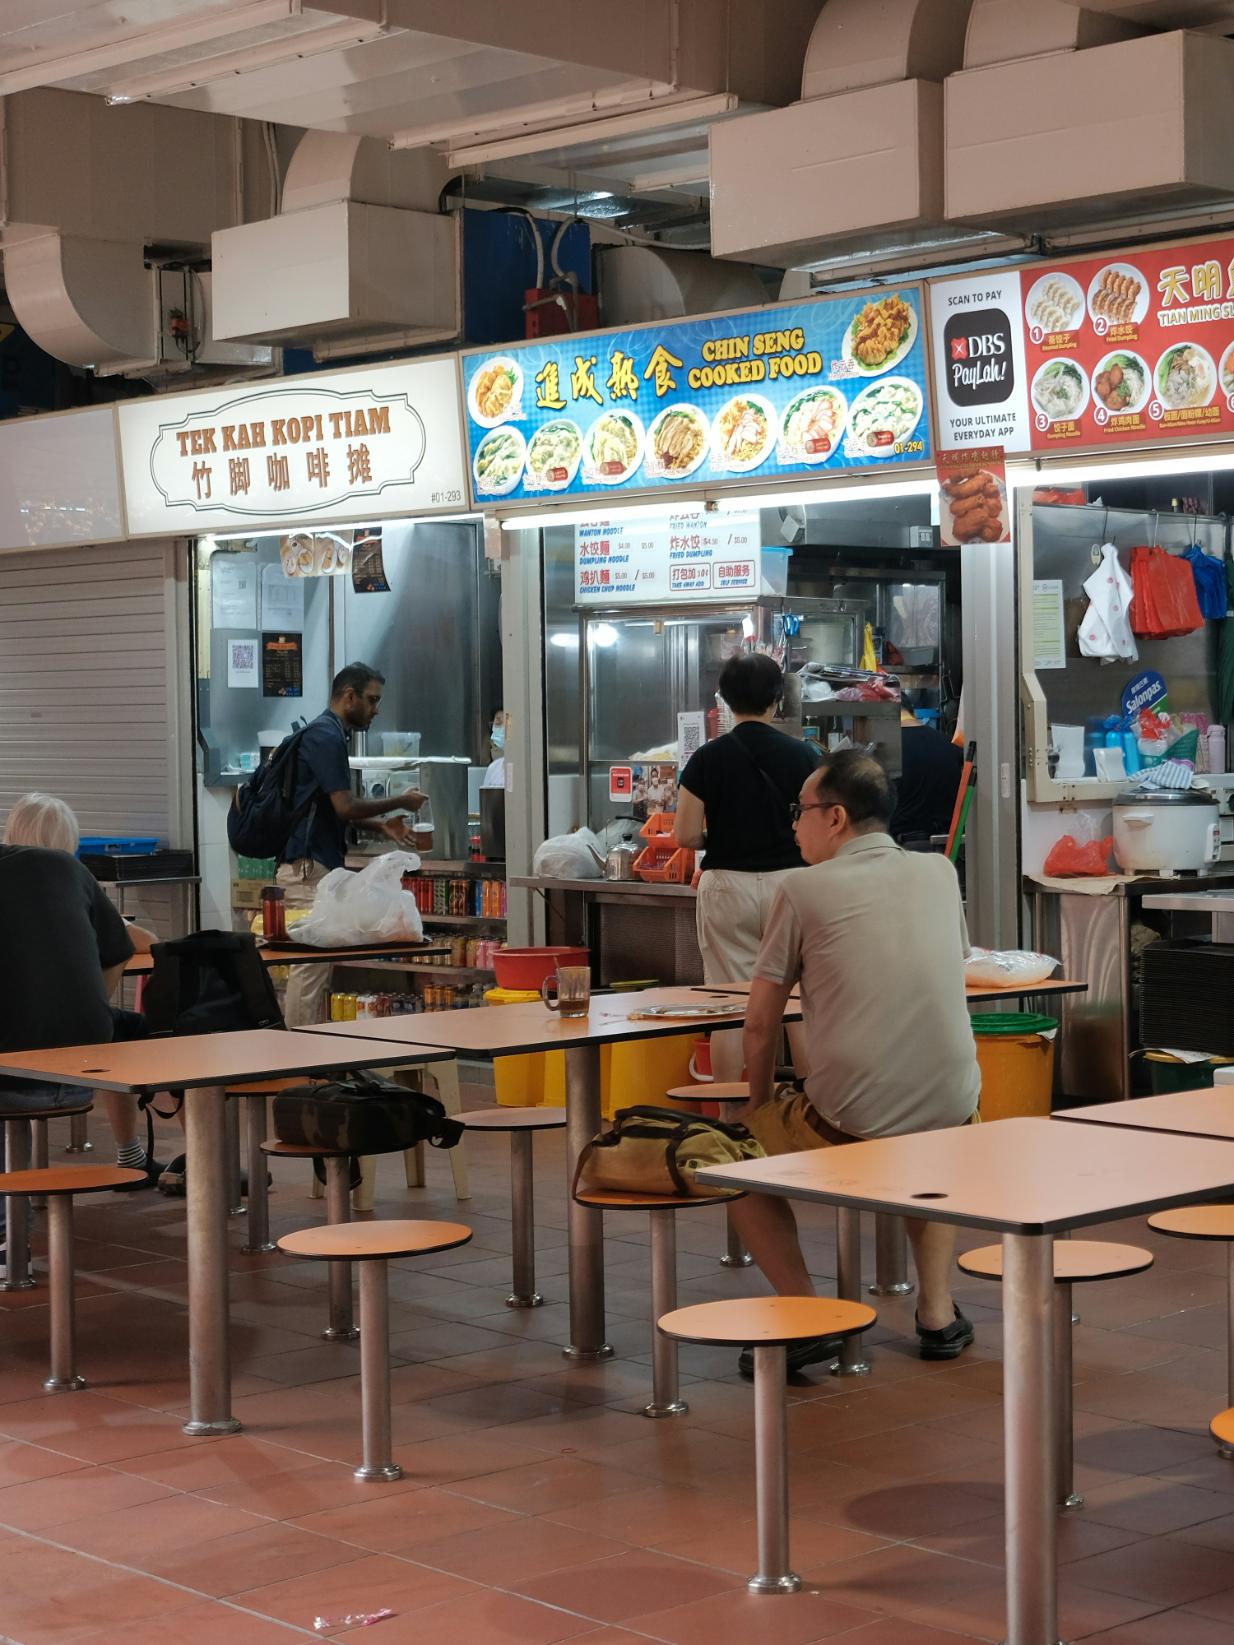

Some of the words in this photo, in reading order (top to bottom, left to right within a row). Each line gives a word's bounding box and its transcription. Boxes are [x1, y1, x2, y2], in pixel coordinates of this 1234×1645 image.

[948, 294, 971, 306] SCAN
[973, 292, 984, 304] TO
[985, 290, 1003, 302] PAY
[1159, 310, 1188, 327] TIAN
[1189, 306, 1221, 324] MING
[702, 337, 749, 362] CHIN
[753, 328, 805, 358] SENG
[968, 332, 1005, 358] DBS
[535, 345, 683, 410] 進成熟食
[688, 360, 765, 391] COOKED
[769, 351, 823, 380] FOOD
[952, 359, 1007, 390] PayLah!
[950, 416, 973, 428] YOUR
[975, 412, 1017, 427] ULTIMATE
[176, 428, 217, 456] TEK
[222, 422, 266, 452] KAH
[271, 415, 324, 446] KOPI
[329, 407, 391, 440] TIAM
[954, 429, 996, 441] EVERYDAY
[998, 426, 1014, 438] APP
[894, 441, 923, 454] 01-294
[191, 443, 373, 499] 竹脚咖啡摊
[431, 490, 462, 504] #01-293
[579, 528, 600, 537] WANTON
[603, 527, 624, 536] NOODLE
[580, 556, 607, 566] DUMPLING
[608, 554, 630, 564] NOODLE
[686, 550, 712, 558] DUMPLING
[718, 564, 750, 578] 自助服务
[580, 586, 600, 594] CHICKEN
[602, 584, 614, 592] CHOP
[616, 584, 636, 592] NOODLE
[1126, 680, 1161, 714] Salonpas
